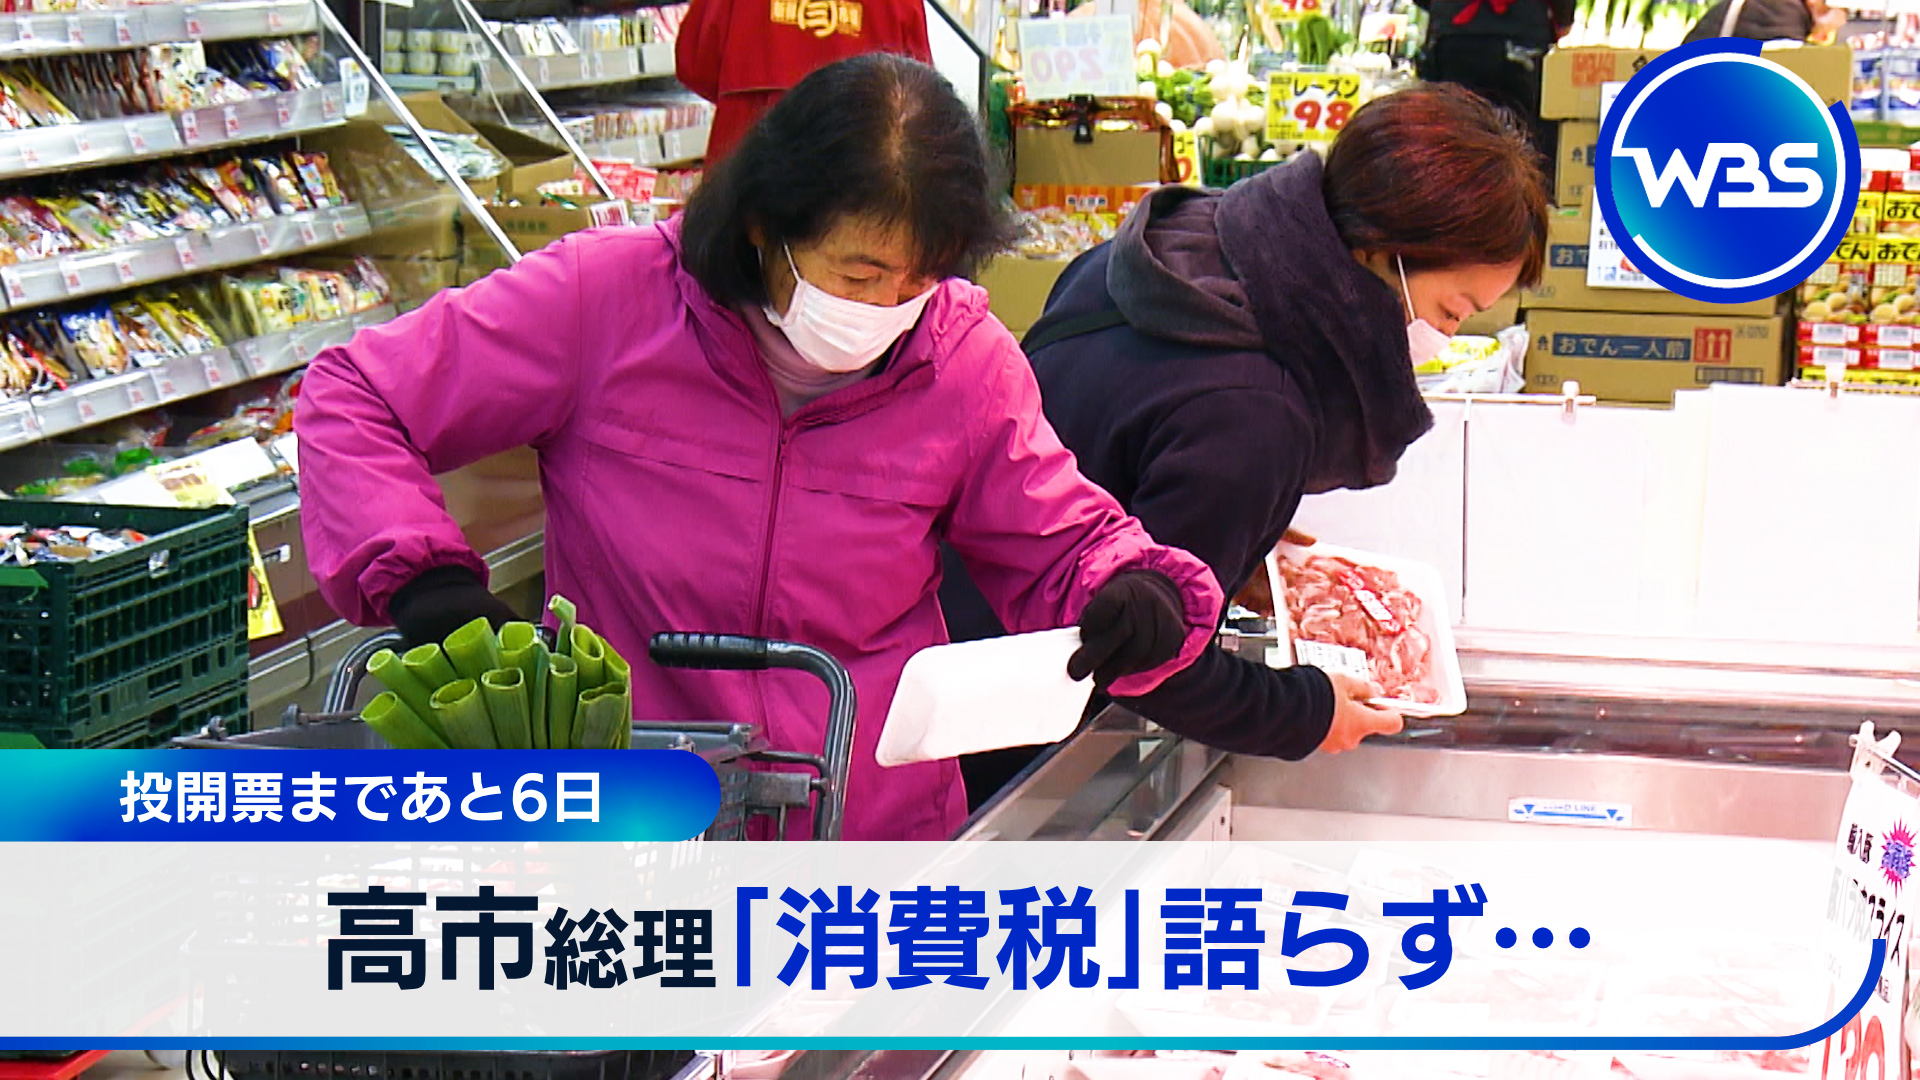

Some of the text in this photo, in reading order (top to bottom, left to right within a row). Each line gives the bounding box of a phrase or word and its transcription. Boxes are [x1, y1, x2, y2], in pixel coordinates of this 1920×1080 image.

[1294, 77, 1359, 99] レーズン
[1294, 100, 1354, 130] 98
[1559, 336, 1687, 360] おでん一人前
